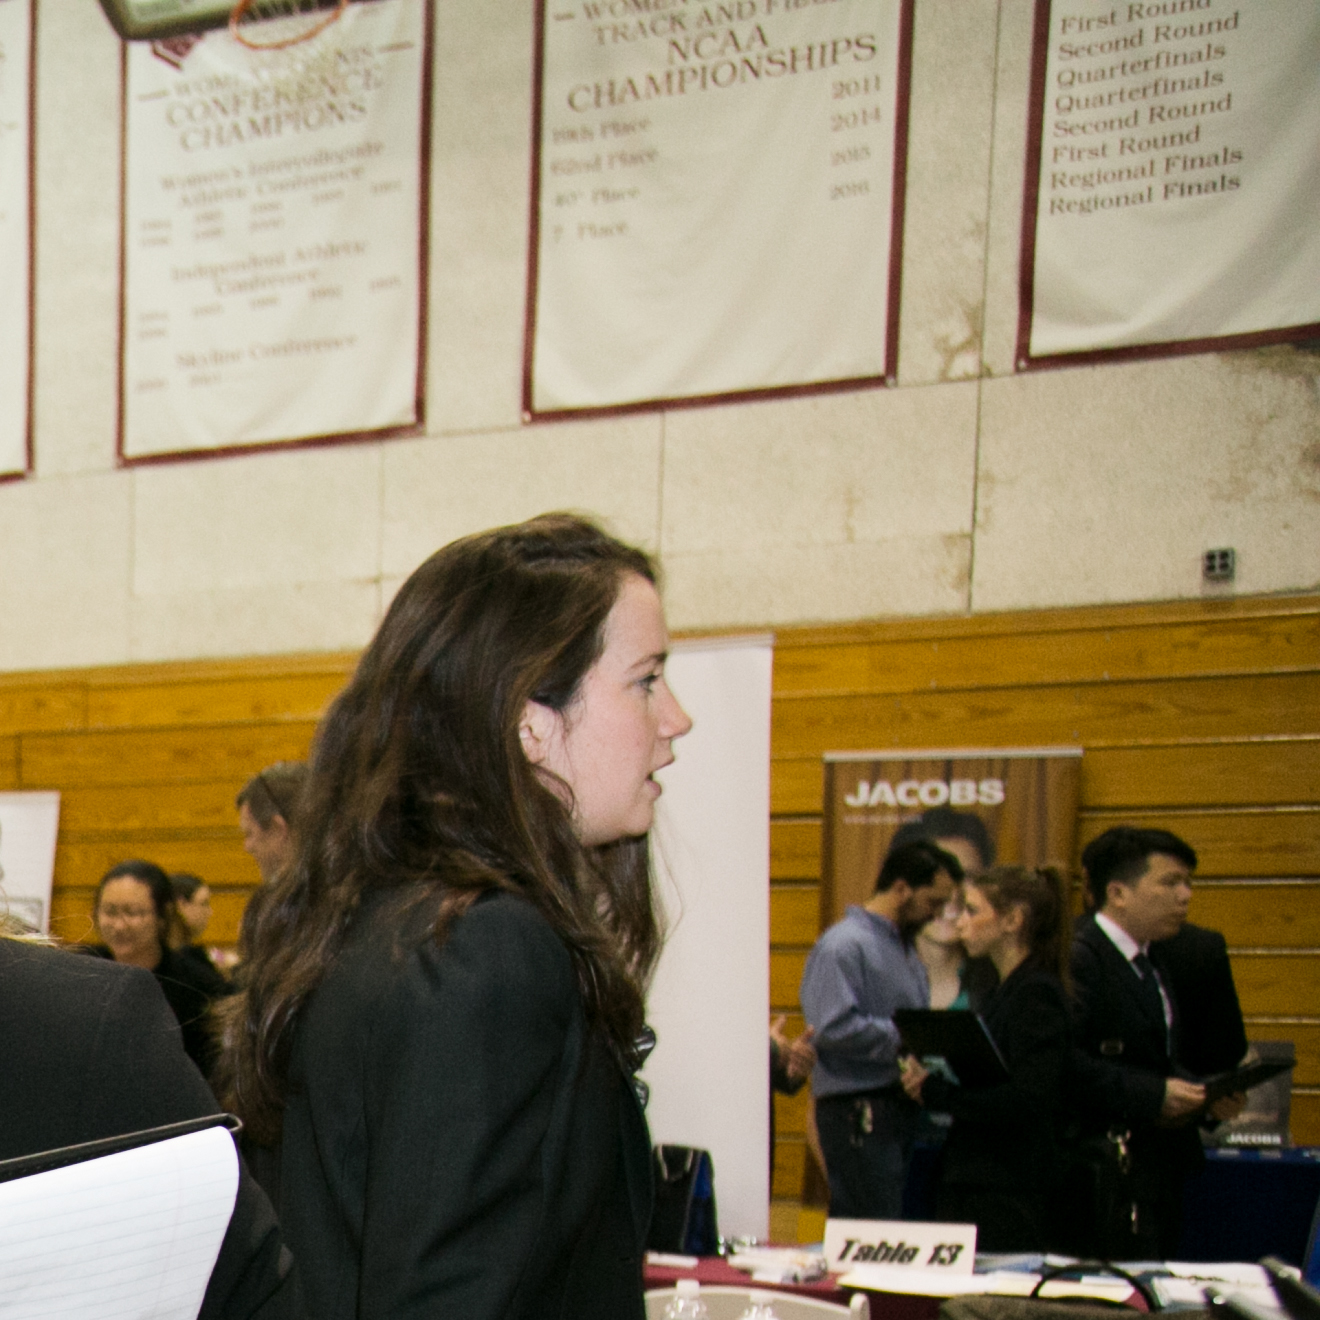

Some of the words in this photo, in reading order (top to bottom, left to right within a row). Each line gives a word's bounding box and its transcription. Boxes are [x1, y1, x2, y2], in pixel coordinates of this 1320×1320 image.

[593, 13, 687, 46] TRACK
[696, 0, 758, 29] AND
[668, 25, 769, 65] NCAA
[1059, 28, 1143, 60] Second
[1155, 10, 1239, 43] Round
[1061, 11, 1116, 35] First
[567, 34, 878, 113] CHAMPIONSHIPS
[1057, 43, 1225, 89] Quarterfinals
[1055, 69, 1223, 115] Quarterfinals
[180, 101, 367, 152] CHAMPIONS
[1053, 109, 1138, 138] Second
[1149, 92, 1231, 125] Round
[1053, 143, 1108, 164] First
[1119, 125, 1200, 155] Round
[1051, 159, 1155, 190] Regional
[1164, 147, 1243, 175] Finals
[1049, 185, 1153, 216] Regional
[1163, 173, 1241, 201] Finals
[844, 779, 1005, 807] JACOBS
[837, 1239, 919, 1264] Table
[927, 1243, 964, 1266] 13
